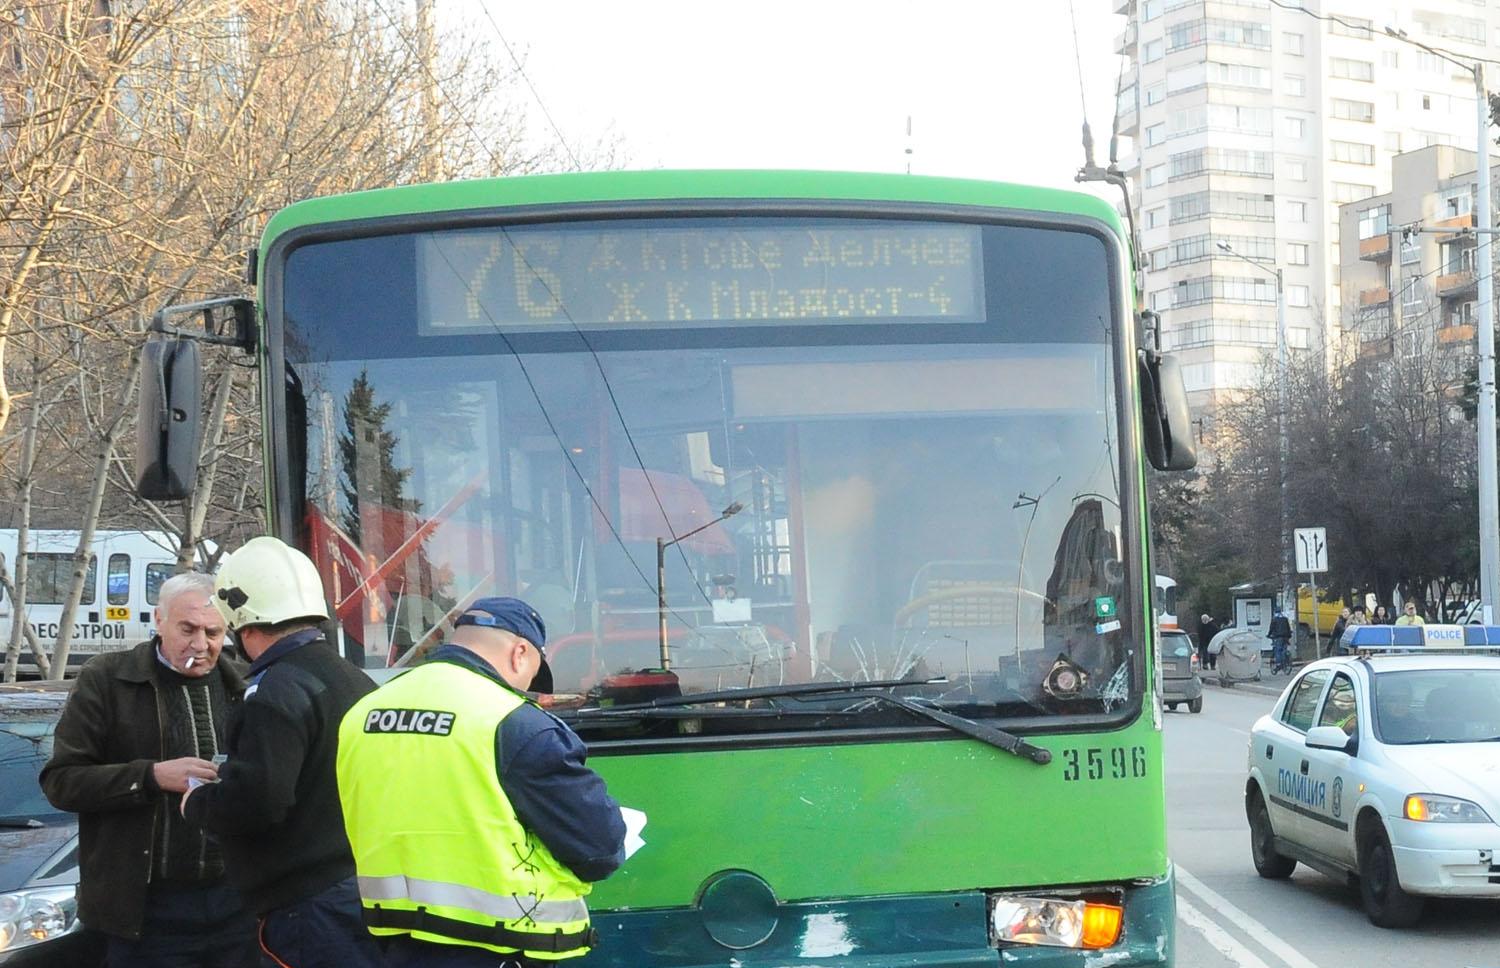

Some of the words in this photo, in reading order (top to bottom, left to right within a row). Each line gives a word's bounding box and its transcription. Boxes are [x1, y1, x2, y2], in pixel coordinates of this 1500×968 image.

[455, 235, 561, 319] 76
[606, 281, 648, 321] Ж
[666, 281, 693, 321] К
[711, 275, 952, 319] Младост-4
[107, 607, 128, 617] 10
[1427, 630, 1461, 640] POLICE
[364, 709, 454, 735] POLICE
[1062, 745, 1146, 781] 3596
[1278, 767, 1326, 809] ПОЛИЦИЯ
